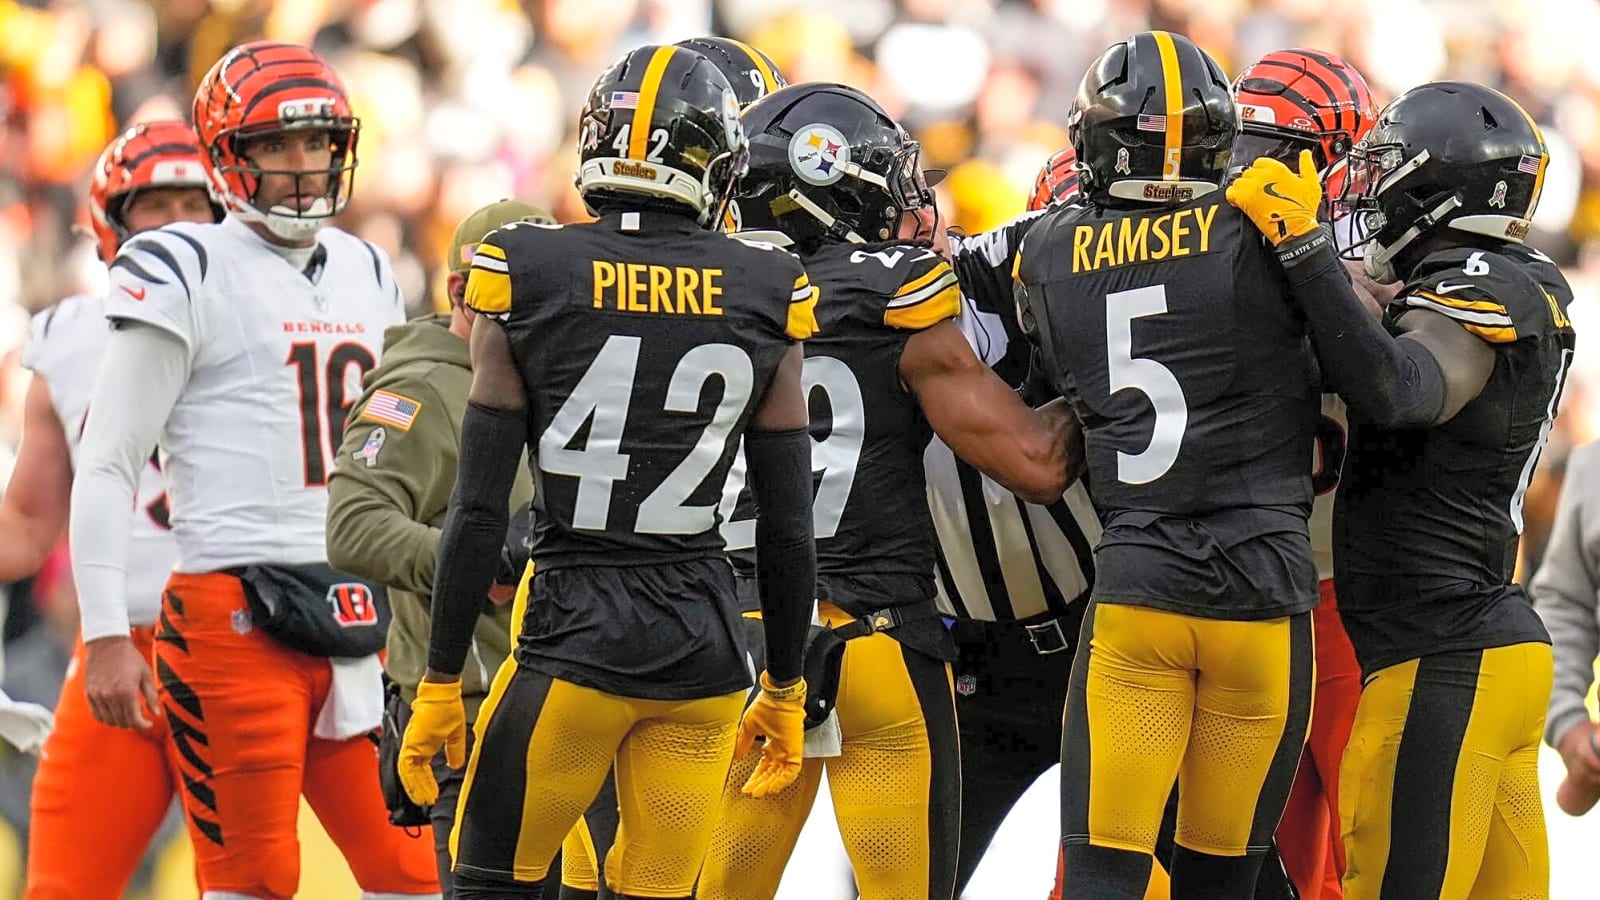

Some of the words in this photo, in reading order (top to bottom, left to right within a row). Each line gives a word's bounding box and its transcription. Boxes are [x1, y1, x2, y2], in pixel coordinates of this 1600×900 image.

[612, 124, 669, 164] 42
[1163, 148, 1180, 180] 5
[613, 160, 657, 180] Steelers
[1143, 183, 1193, 200] Steelers
[1072, 204, 1219, 273] RAMSEY
[1462, 252, 1490, 277] 6
[592, 260, 723, 315] PIERRE
[283, 321, 365, 333] BENGALS
[1106, 284, 1188, 485] 5
[285, 340, 376, 488] 16
[539, 335, 754, 535] 42
